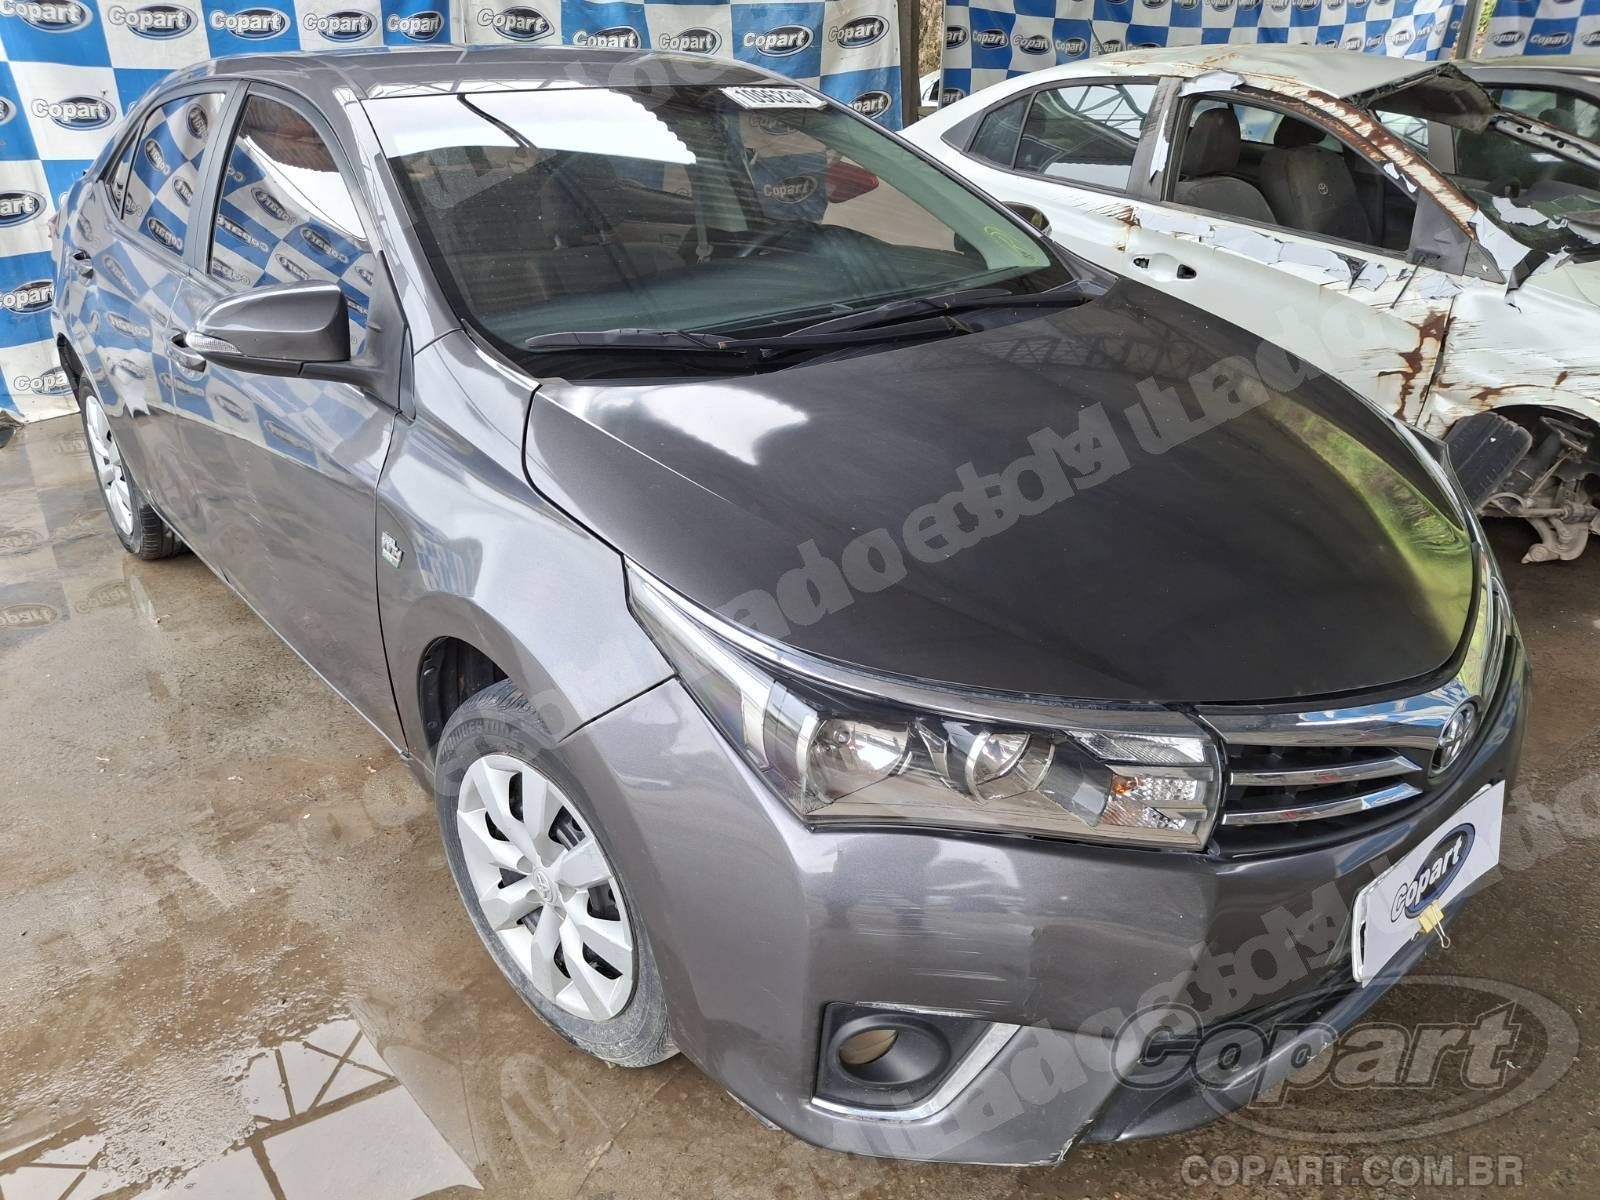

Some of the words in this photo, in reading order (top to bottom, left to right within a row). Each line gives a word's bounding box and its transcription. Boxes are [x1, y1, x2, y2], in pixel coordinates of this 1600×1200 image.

[109, 6, 189, 31] Copart
[210, 10, 281, 34] Copart
[303, 13, 369, 36] Copart
[477, 8, 547, 33] Copart
[573, 30, 637, 48] Copart
[743, 32, 806, 51] Copart
[828, 20, 882, 42] Copart
[946, 30, 965, 42] art
[972, 30, 1006, 44] Copart
[1530, 34, 1570, 45] Copart
[659, 33, 714, 51] Copart
[1055, 39, 1084, 54] Copart
[32, 99, 108, 122] Copart
[850, 96, 885, 114] part
[763, 180, 810, 198] Copart
[0, 194, 35, 215] art
[0, 285, 54, 311] opart
[14, 372, 68, 393] Copa
[1391, 834, 1463, 923] Copart
